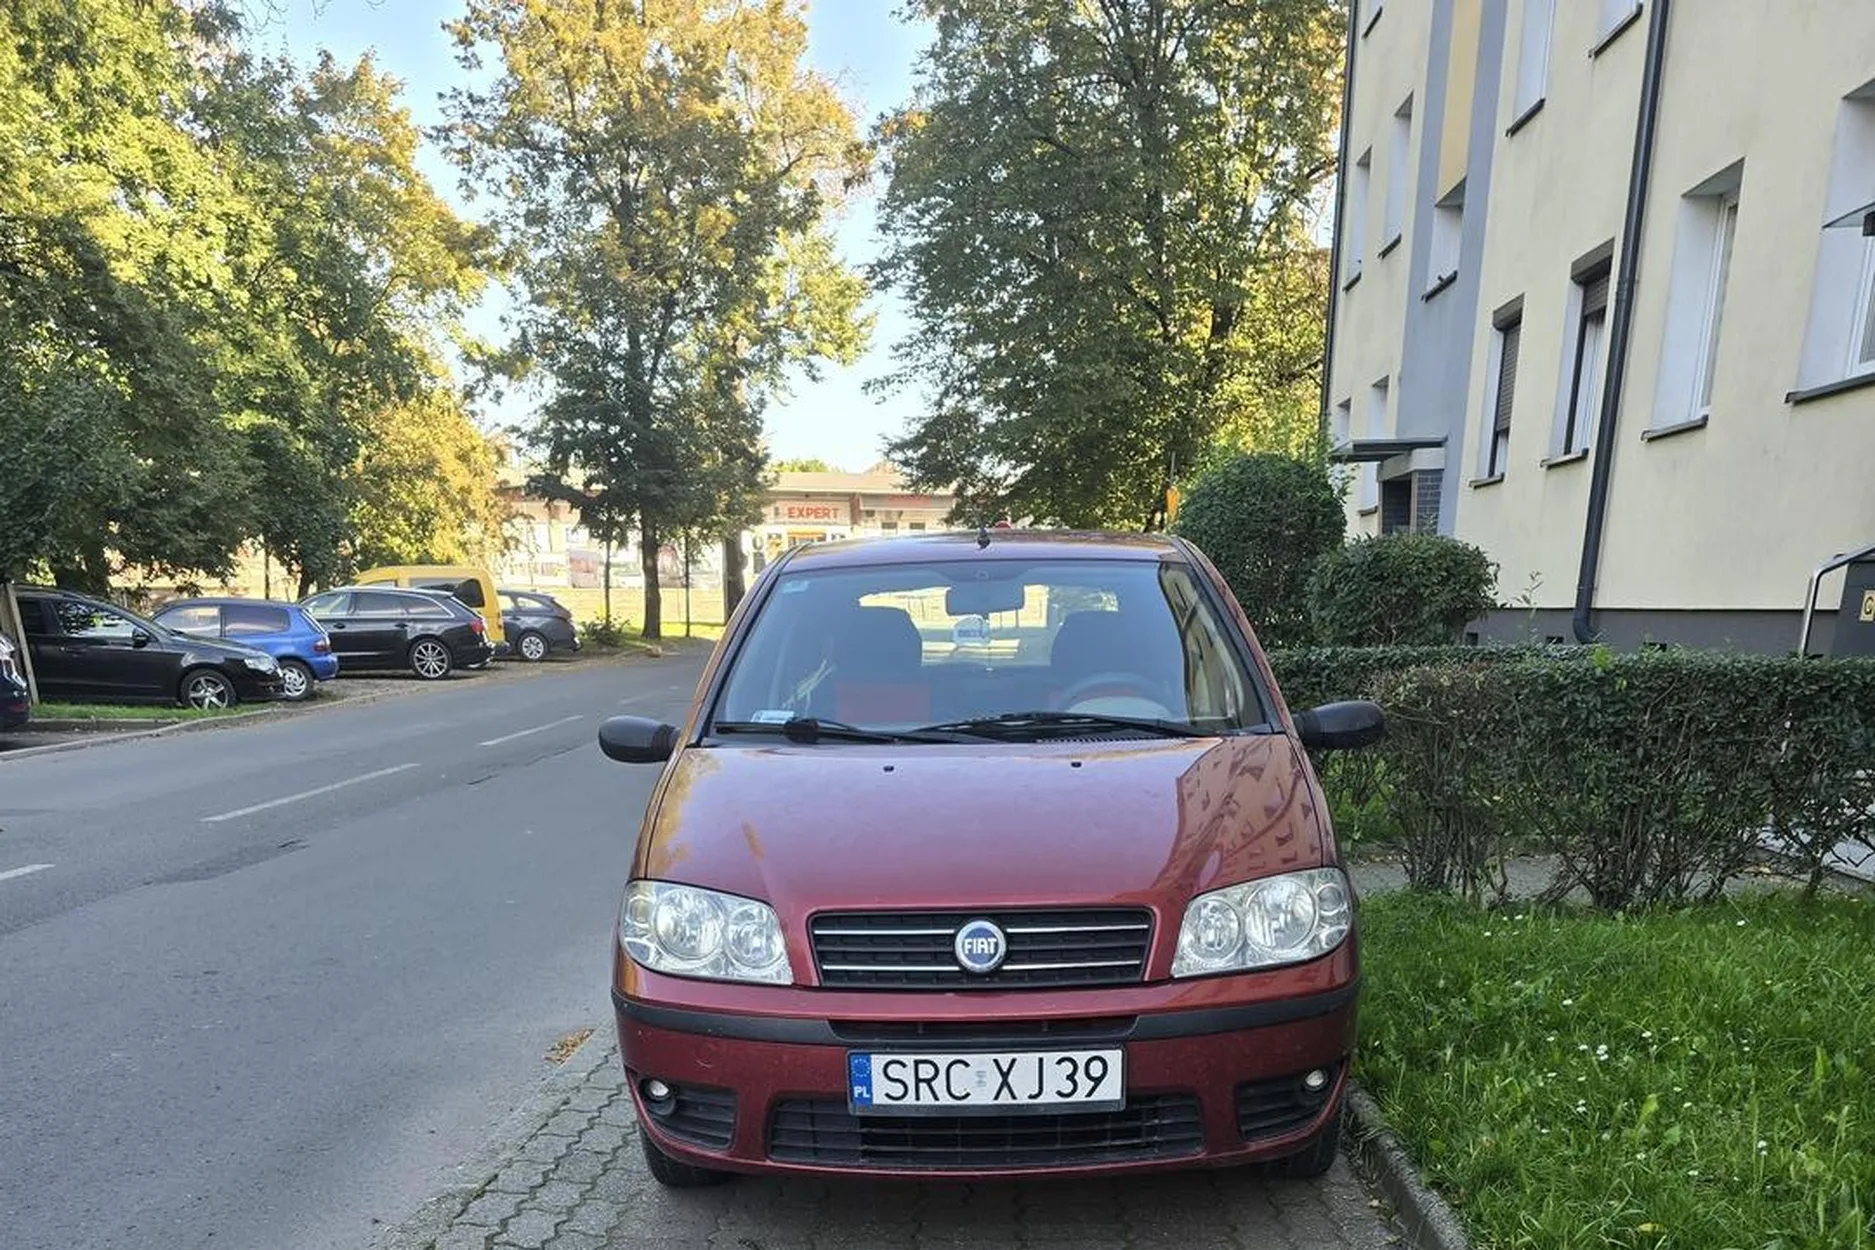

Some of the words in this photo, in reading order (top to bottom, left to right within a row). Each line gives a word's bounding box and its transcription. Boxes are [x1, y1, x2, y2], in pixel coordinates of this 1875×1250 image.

[787, 506, 840, 519] EXPERT
[964, 937, 998, 954] FIAT
[883, 1059, 971, 1101] SRC
[992, 1055, 1108, 1101] XJ39
[853, 1086, 871, 1098] PL
